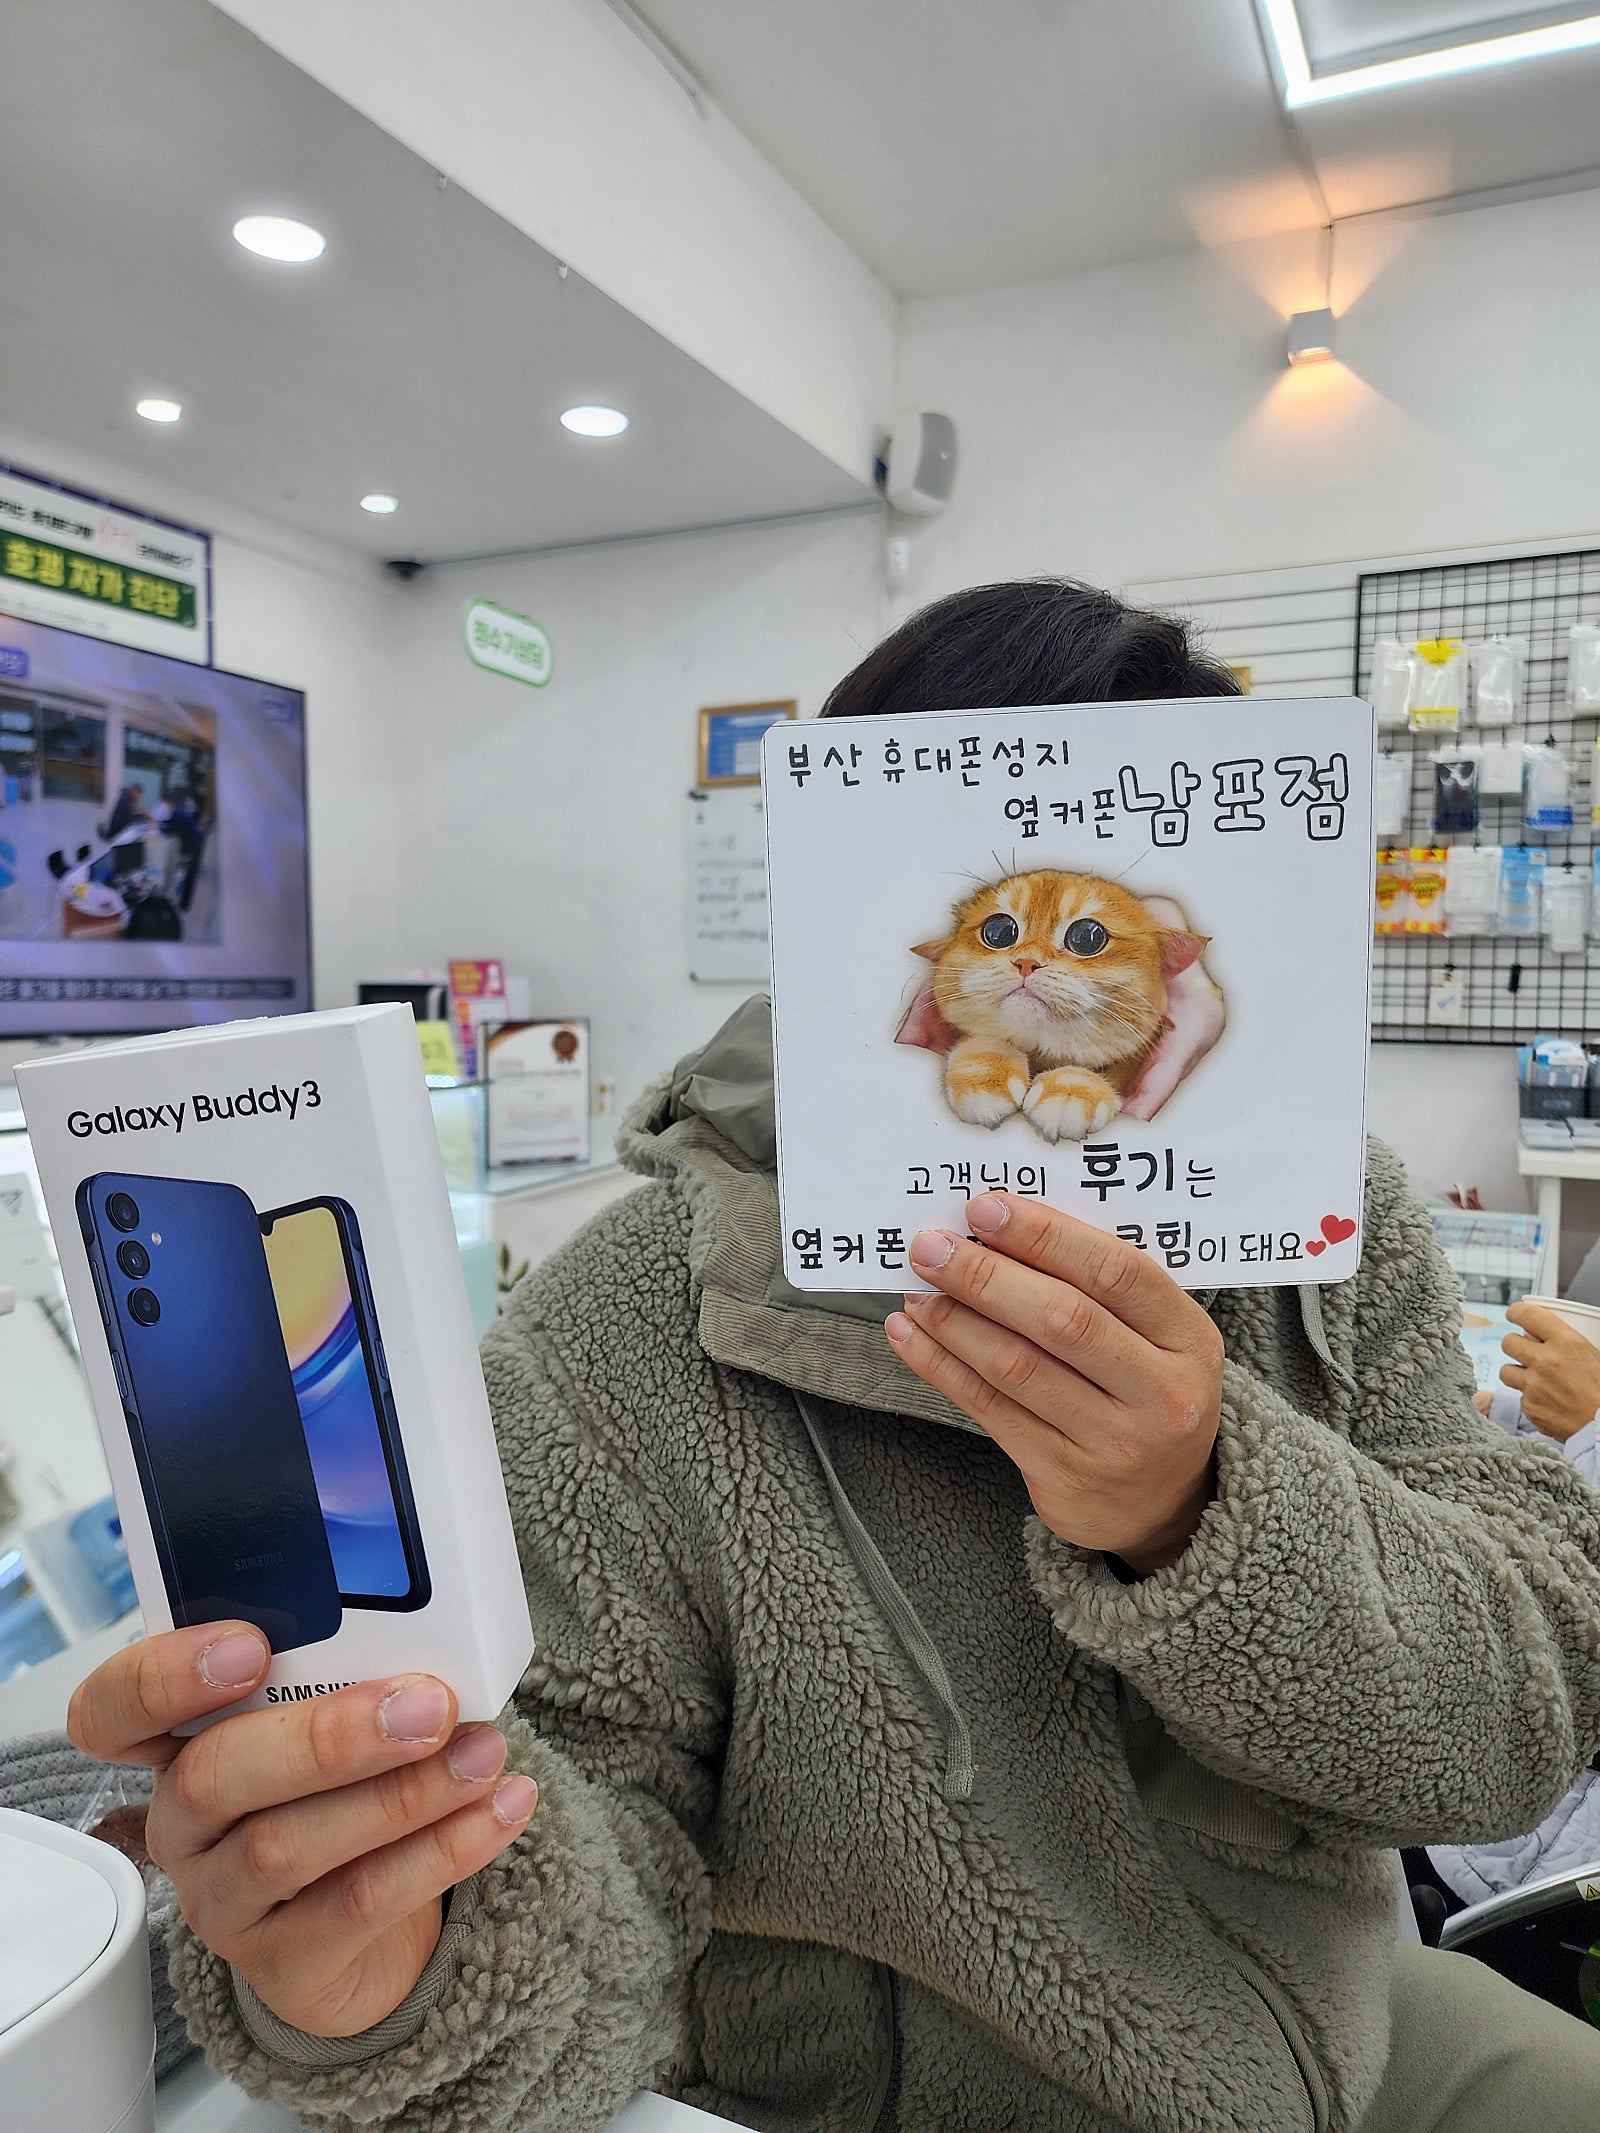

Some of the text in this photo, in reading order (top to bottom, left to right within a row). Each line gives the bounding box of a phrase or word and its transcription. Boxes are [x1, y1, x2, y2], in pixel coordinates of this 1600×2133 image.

[789, 744, 862, 788] 부산
[1118, 753, 1349, 848] 남포점
[67, 1080, 322, 1138] Galaxy Buddy3
[906, 1142, 1216, 1202] 고객님의 후기는
[265, 1681, 357, 1704] SAMS
